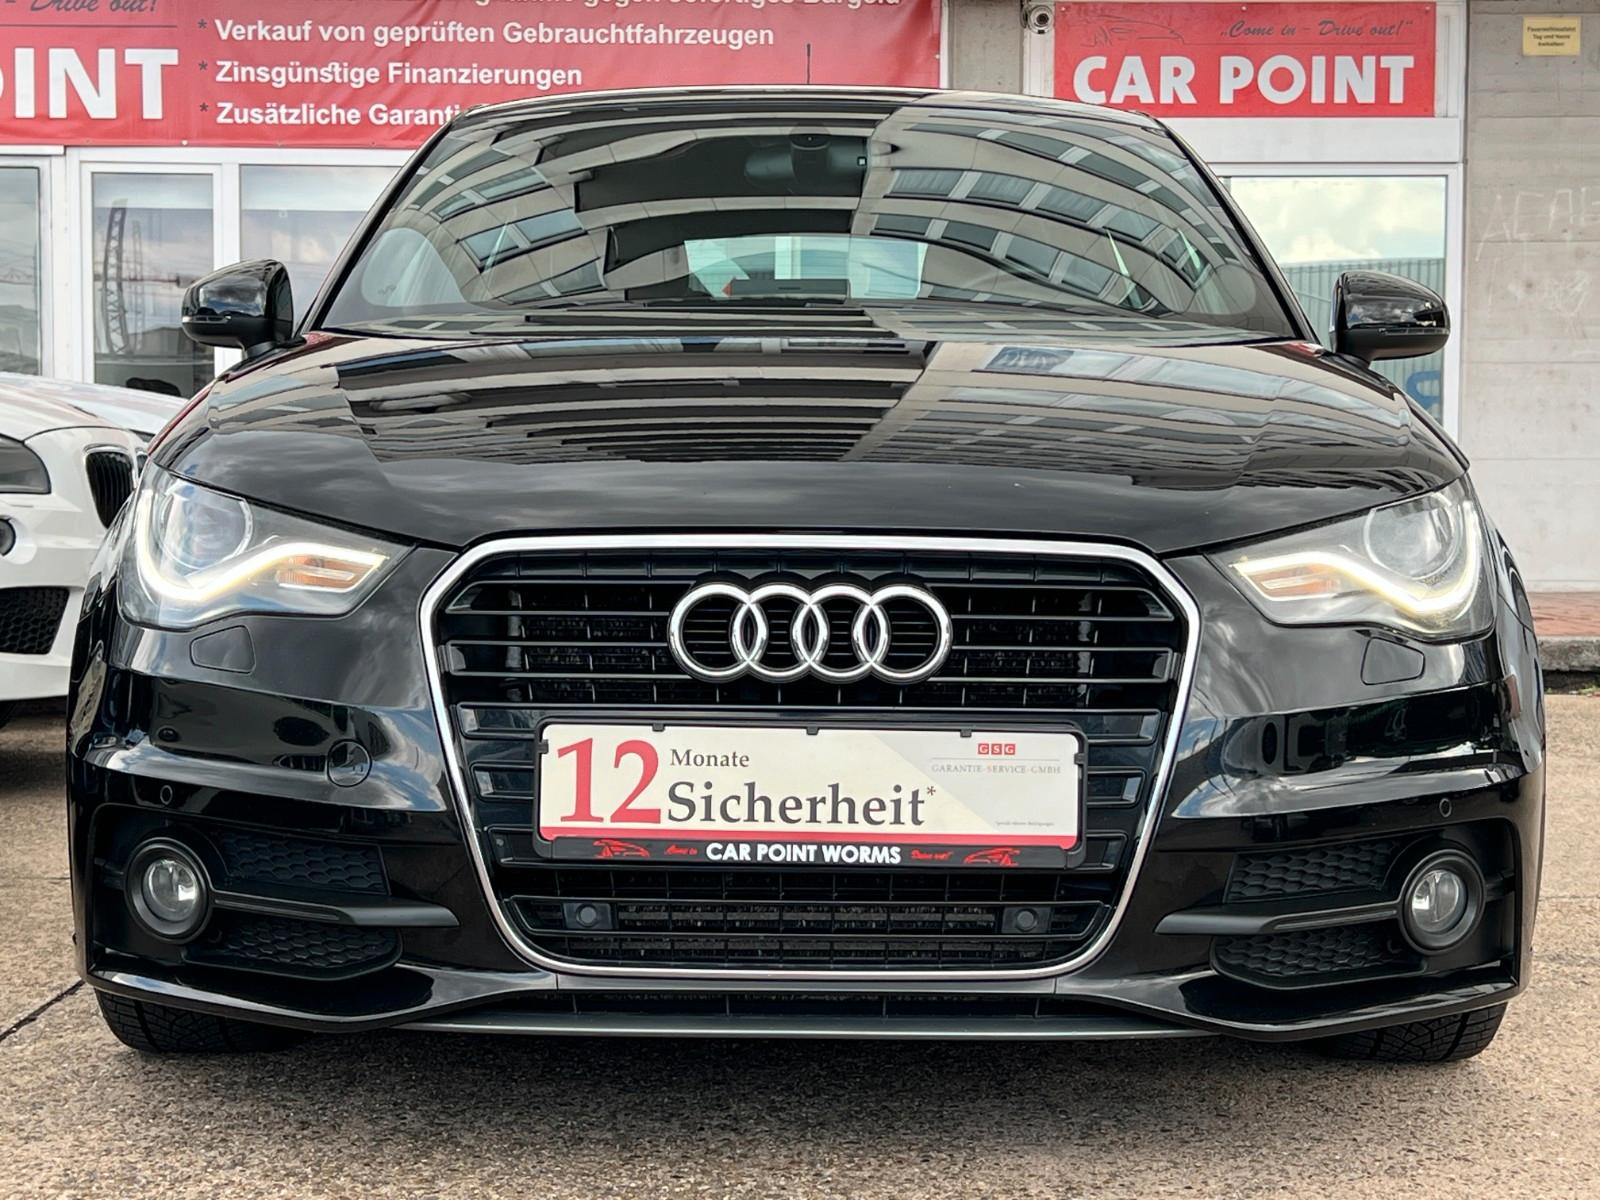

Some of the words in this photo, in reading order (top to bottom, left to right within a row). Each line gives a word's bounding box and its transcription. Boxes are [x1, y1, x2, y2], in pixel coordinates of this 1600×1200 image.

[215, 20, 311, 43] Verkauf
[319, 25, 366, 43] von
[373, 21, 495, 48] geprüften
[503, 22, 774, 51] Gebrauchtfahrzeugen
[1280, 23, 1297, 36] in
[1318, 18, 1364, 37] Drive
[0, 48, 179, 120] INT
[215, 61, 380, 88] Zinsgünstige
[389, 64, 582, 88] Finanzierungen
[1072, 54, 1198, 106] CAR
[1218, 54, 1416, 105] POINT
[216, 103, 361, 126] Zusätzliche
[670, 748, 750, 768] Monate
[977, 743, 1016, 756] GSG
[557, 737, 661, 824] 12
[931, 764, 982, 774] GARANTIE
[986, 764, 1025, 775] SERVICE
[705, 842, 752, 861] CAR
[756, 843, 818, 863] POINT
[821, 844, 902, 864] WORMS
